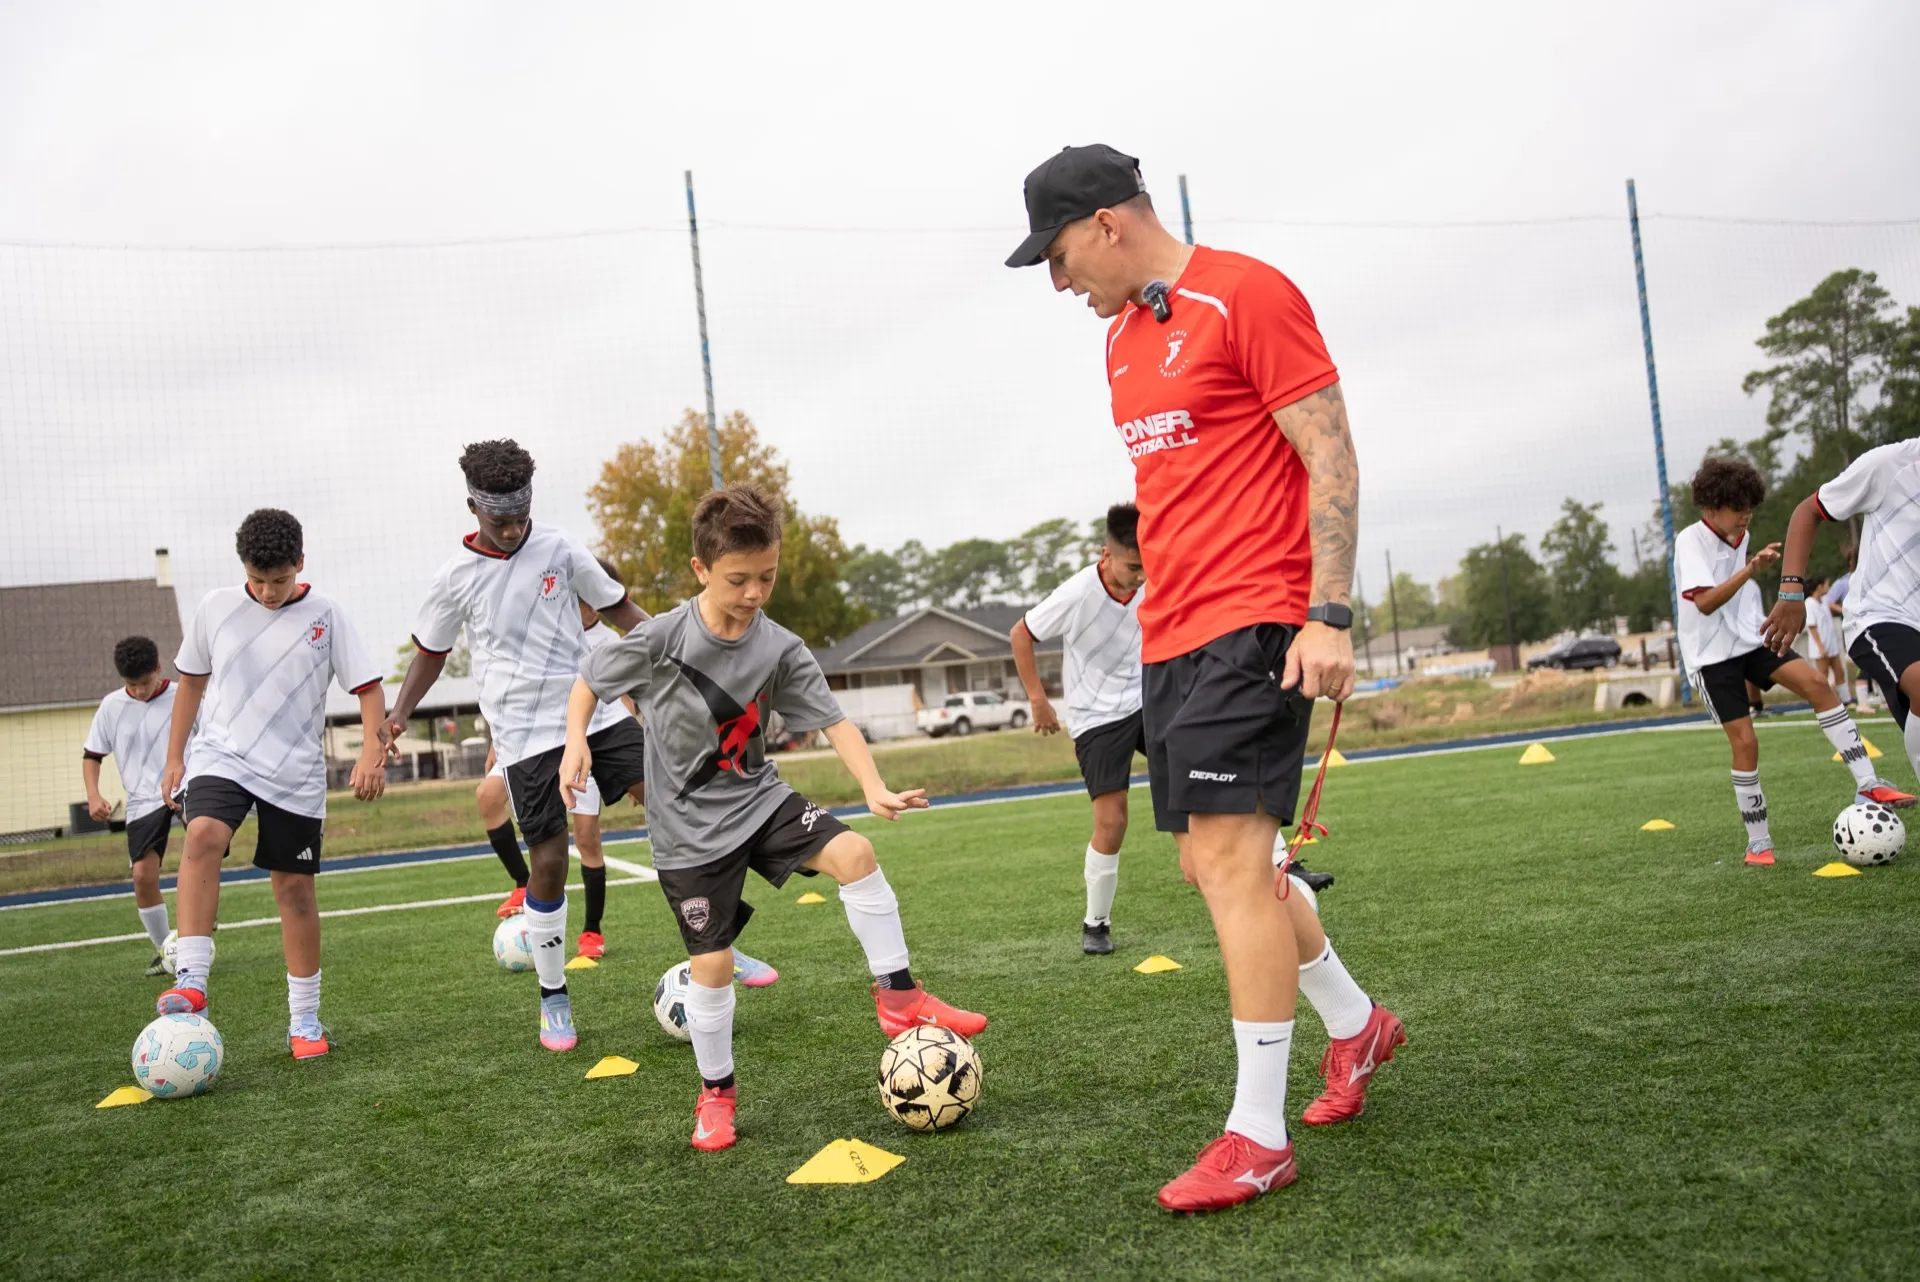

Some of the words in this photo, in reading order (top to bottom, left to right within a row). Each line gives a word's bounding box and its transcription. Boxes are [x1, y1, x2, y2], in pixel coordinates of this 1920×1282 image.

[1116, 410, 1195, 444] ONER
[1128, 432, 1199, 459] OTBALL
[1188, 769, 1238, 783] DEPLOY
